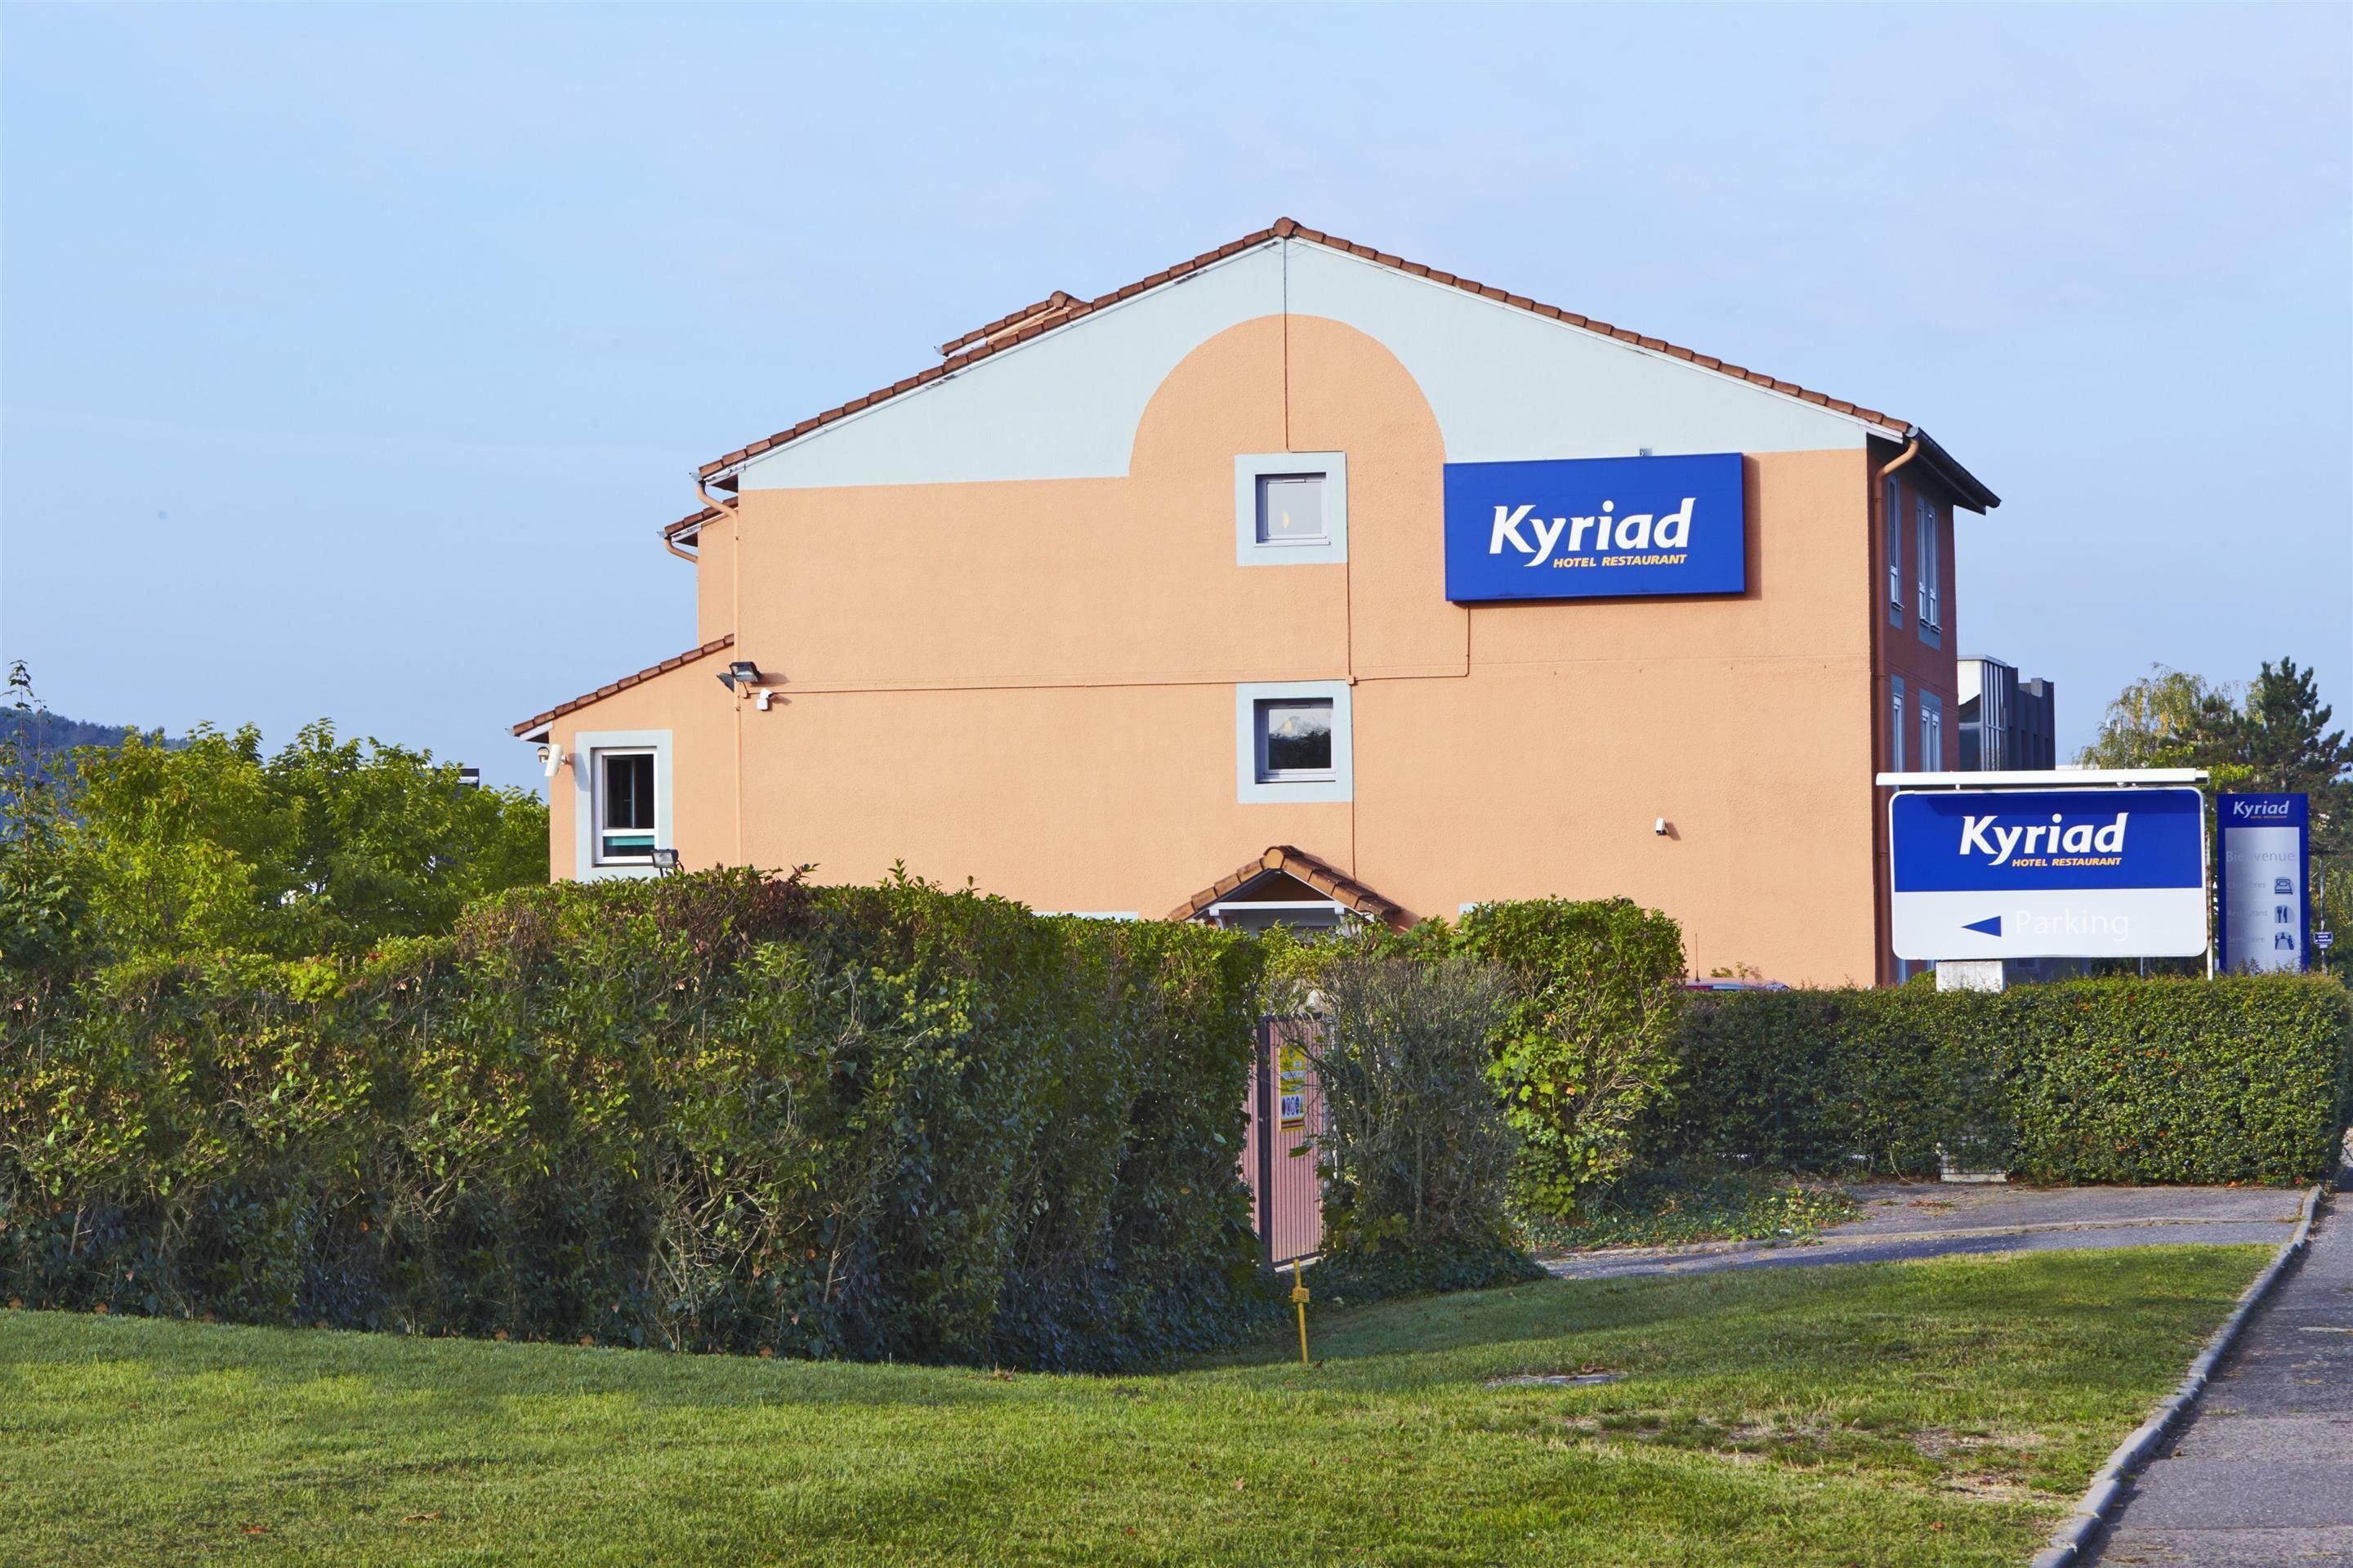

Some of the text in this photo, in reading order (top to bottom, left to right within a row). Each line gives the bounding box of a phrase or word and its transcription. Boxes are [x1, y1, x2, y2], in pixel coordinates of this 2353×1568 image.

[1489, 497, 1697, 567] Kyriad
[1553, 553, 1688, 569] HOTEL RESTAURANT
[2233, 800, 2290, 818] Kyriad
[1959, 811, 2130, 866] Kyriad
[2011, 856, 2123, 867] HOTEL RESTAURANT
[2226, 851, 2294, 863] Bievenue
[2016, 909, 2130, 942] Parking
